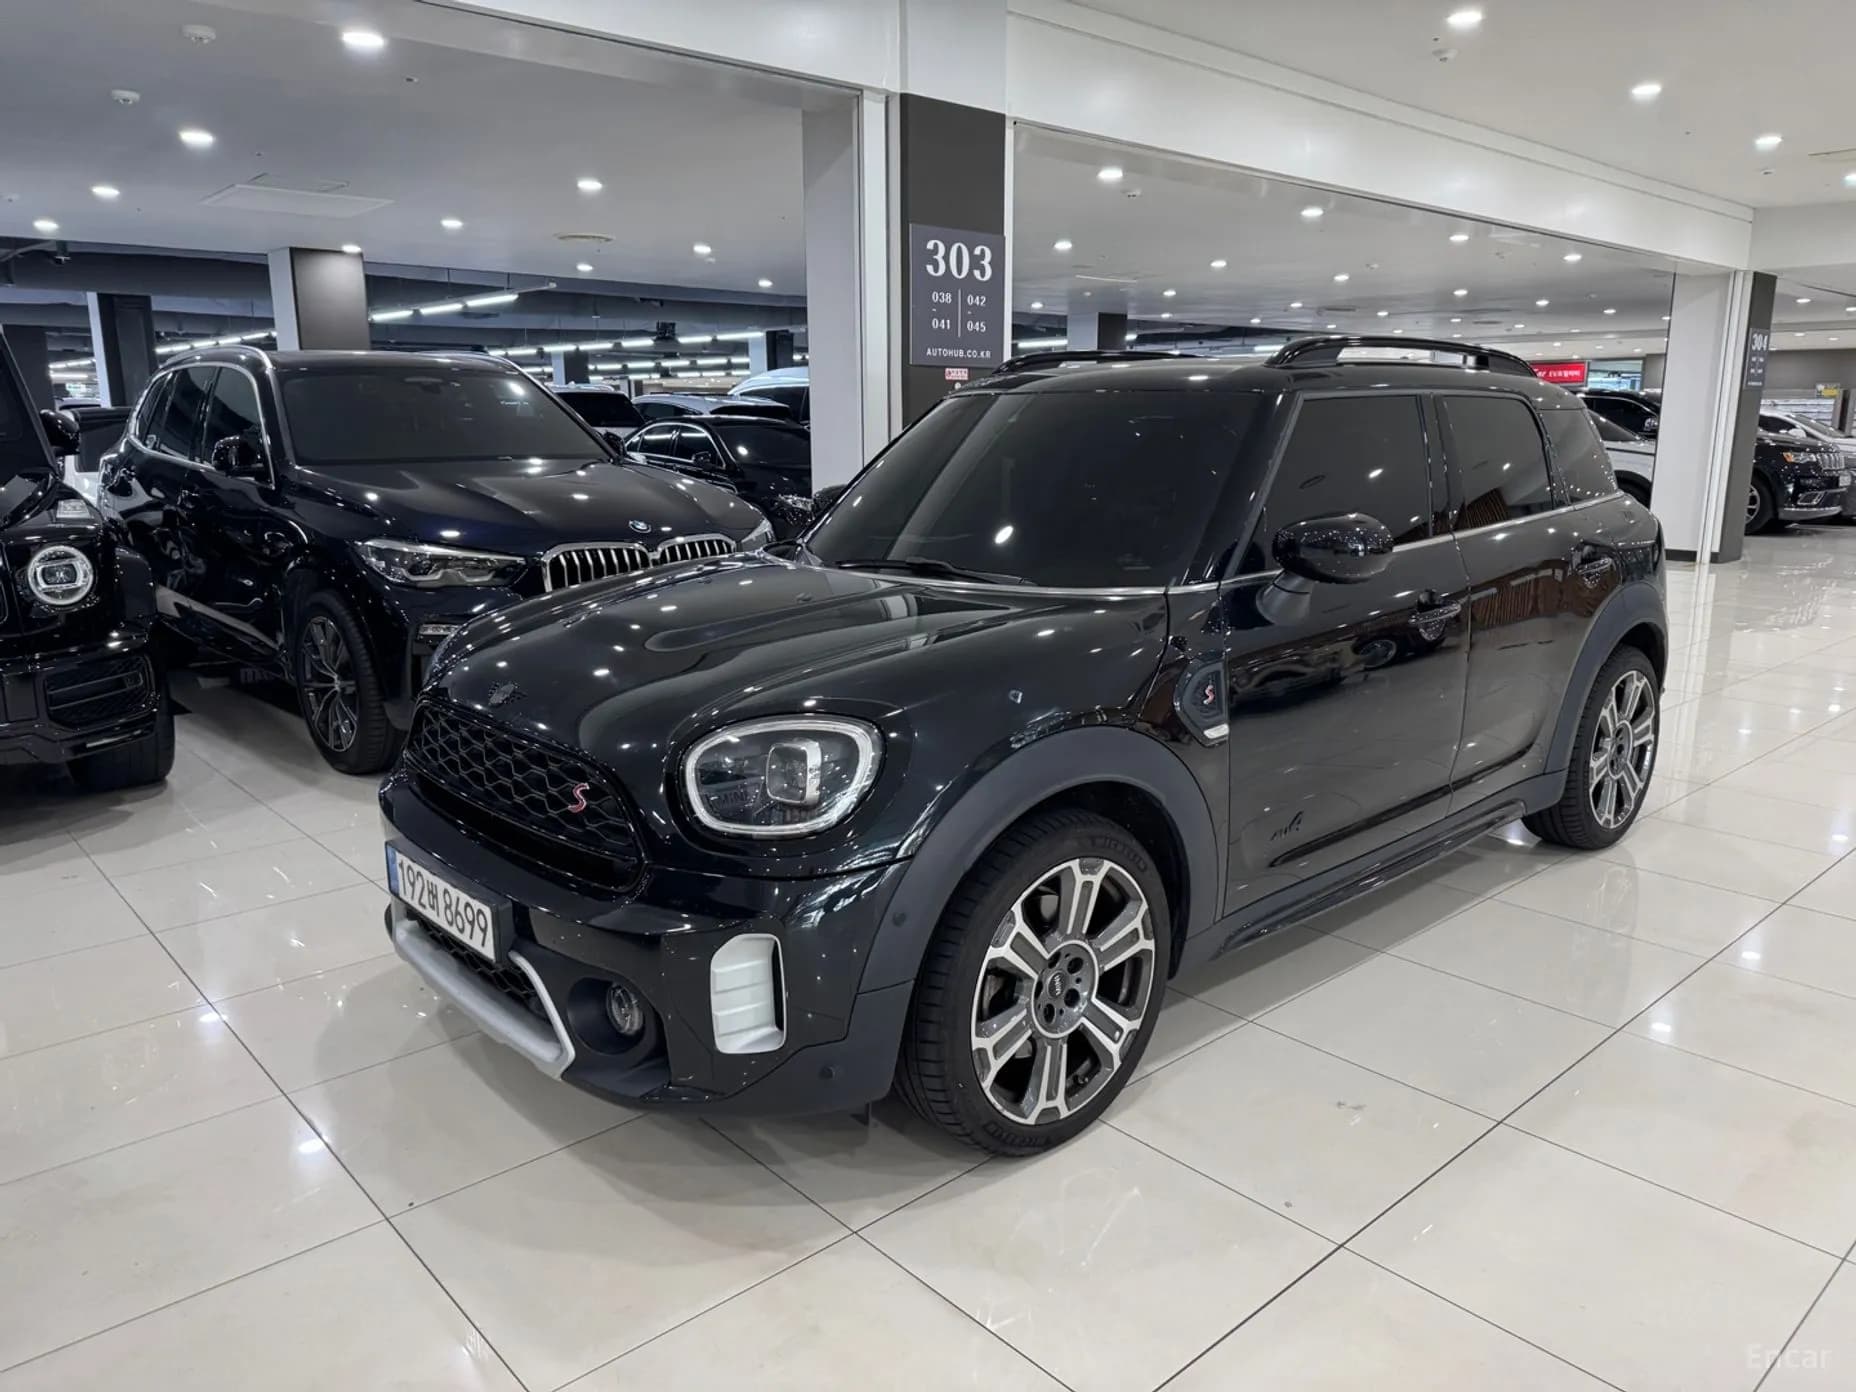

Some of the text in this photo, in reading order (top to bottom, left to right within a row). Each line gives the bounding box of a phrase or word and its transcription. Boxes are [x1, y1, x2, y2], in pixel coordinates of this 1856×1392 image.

[926, 239, 992, 282] 303
[932, 291, 952, 304] 038
[967, 294, 986, 307] 042
[932, 317, 950, 330] 041
[967, 320, 986, 332] 045
[926, 347, 991, 358] AUTOHUB.CO.KR
[567, 782, 590, 813] S
[443, 887, 488, 948] 8699
